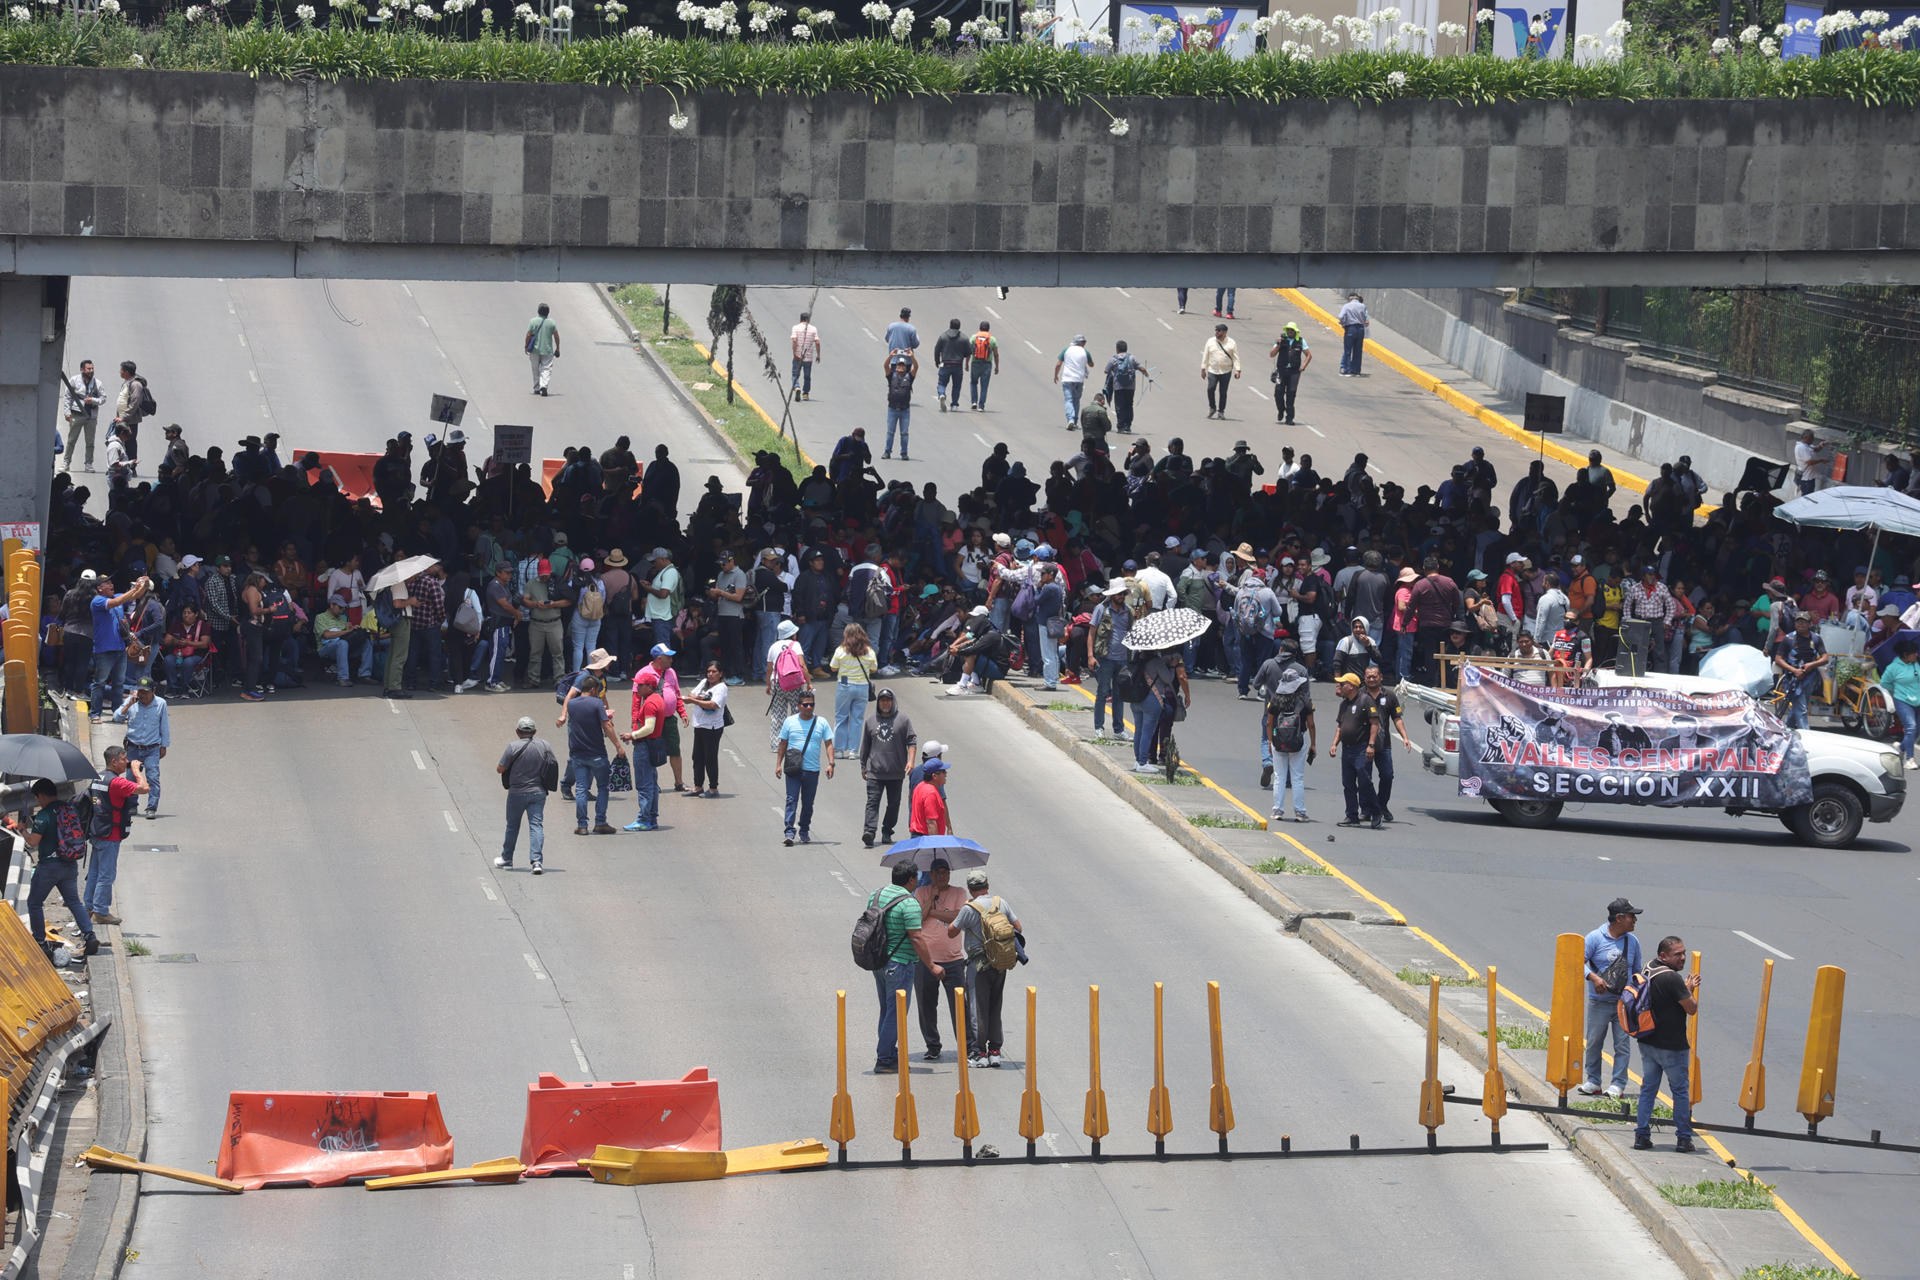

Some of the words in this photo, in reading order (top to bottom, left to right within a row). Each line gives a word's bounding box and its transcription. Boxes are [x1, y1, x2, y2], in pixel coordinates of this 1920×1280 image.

[1564, 687, 1609, 697] NACIONAL
[1616, 689, 1628, 697] DE
[1548, 696, 1594, 707] NACIONAL
[1598, 699, 1609, 707] DE
[1686, 703, 1698, 711] DE
[1499, 739, 1610, 771] VALLES
[1618, 746, 1782, 774] CENTRALES
[1533, 771, 1680, 797] SECCIÓN
[1694, 776, 1759, 798] XXII
